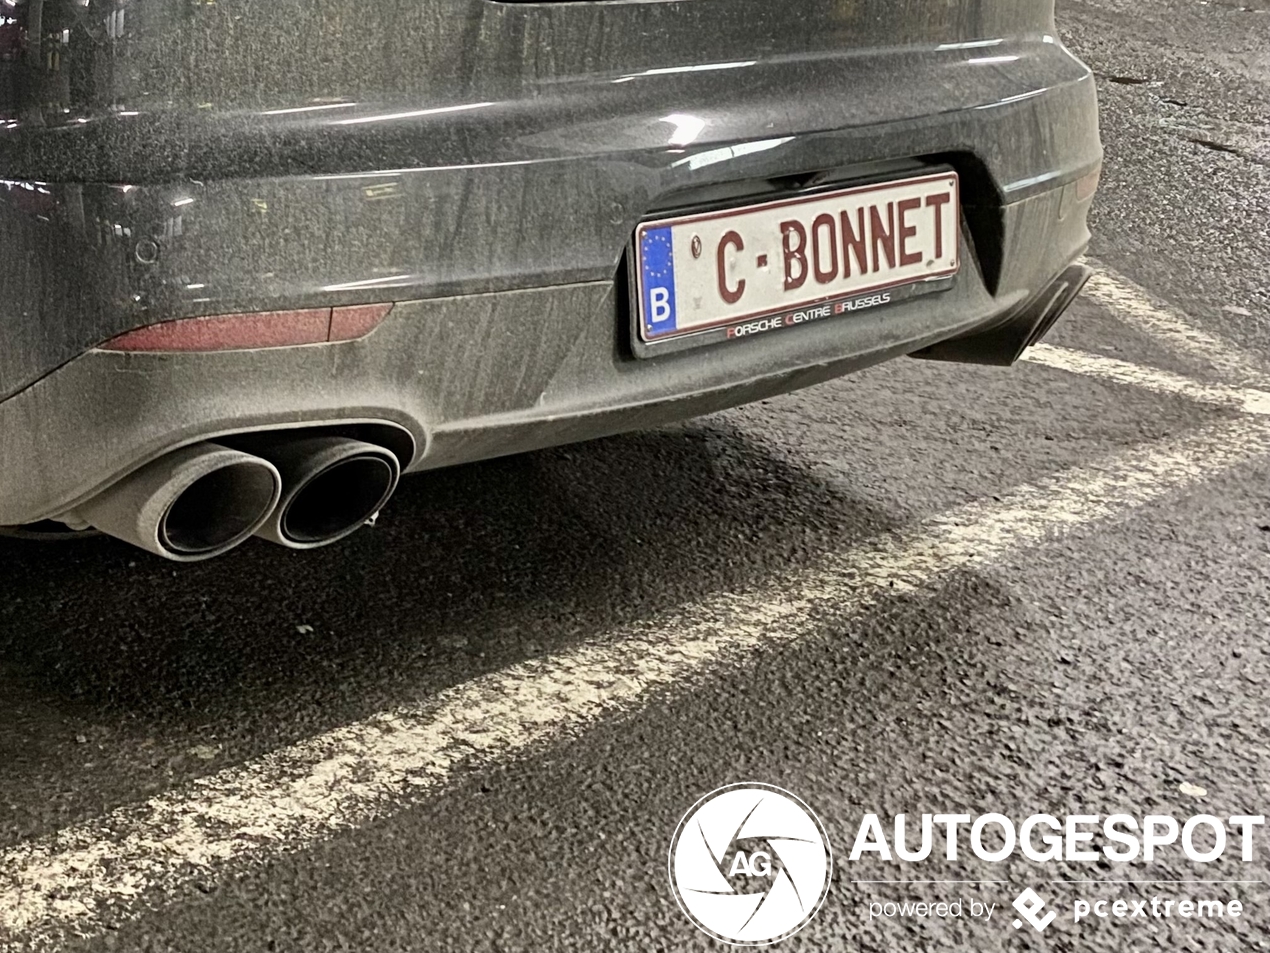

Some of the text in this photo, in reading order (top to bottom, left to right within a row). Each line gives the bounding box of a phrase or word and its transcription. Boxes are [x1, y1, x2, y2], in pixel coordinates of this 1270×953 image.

[650, 287, 671, 323] B
[727, 293, 890, 338] PORSCHE CENTRE BRUSSELS
